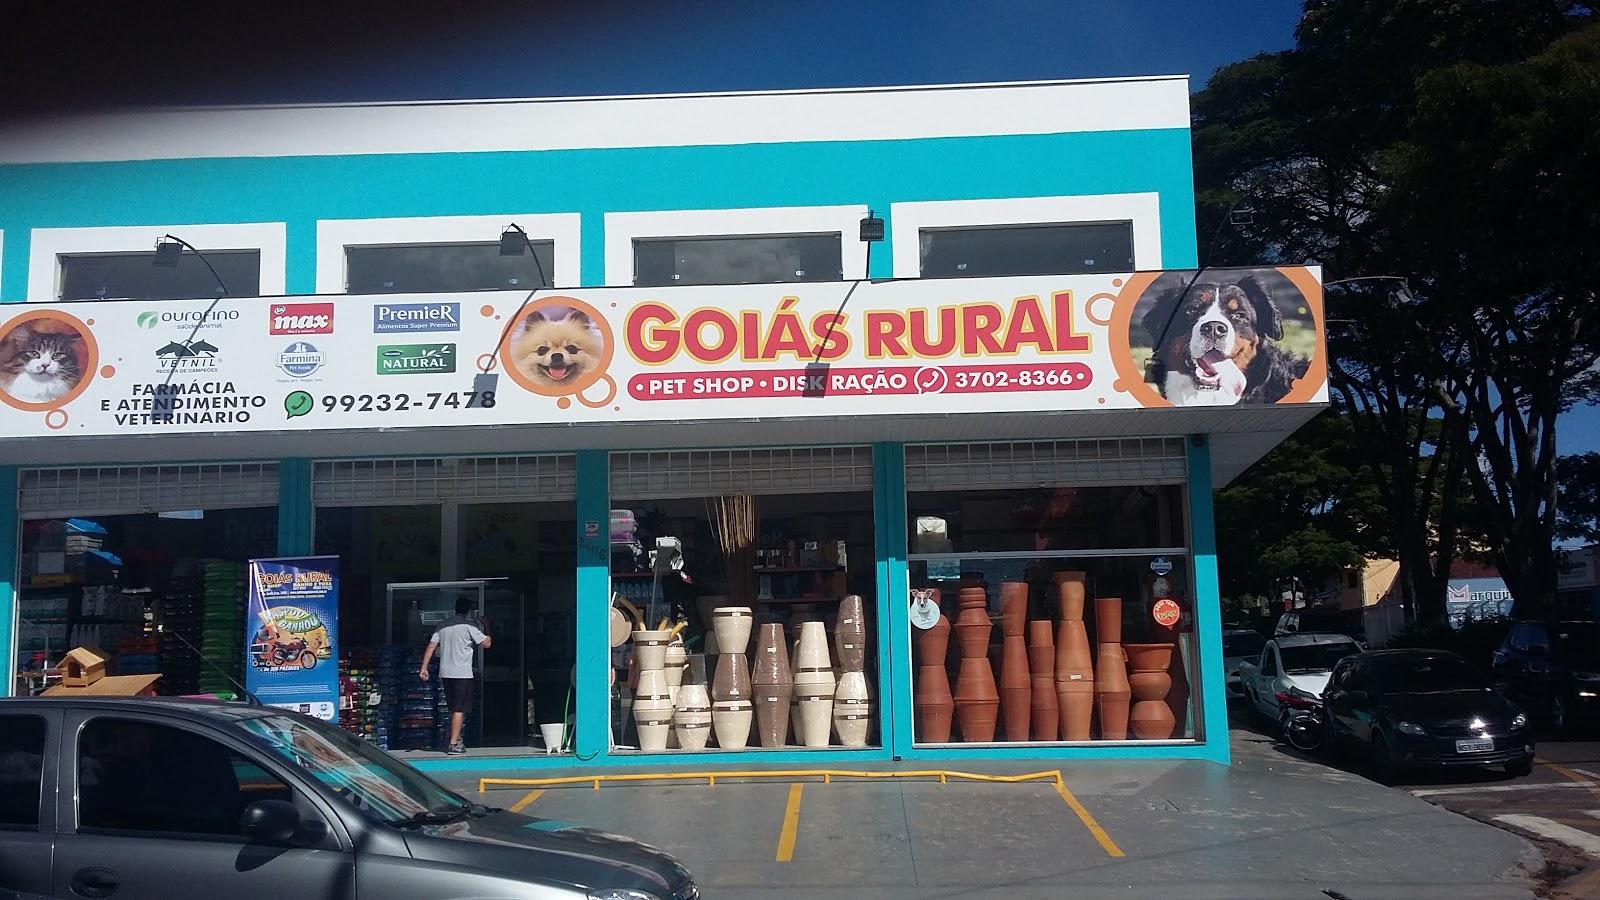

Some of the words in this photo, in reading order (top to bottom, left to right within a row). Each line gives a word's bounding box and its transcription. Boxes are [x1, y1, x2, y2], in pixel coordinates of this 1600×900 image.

[274, 315, 329, 330] max
[410, 322, 428, 331] Super
[430, 321, 458, 329] Premium
[624, 296, 852, 366] GOIÁS
[863, 290, 1093, 359] RURAL
[160, 359, 216, 368] VETNIL
[280, 353, 321, 363] Farmina
[383, 357, 448, 369] NATURAL
[132, 379, 236, 396] FARMÁCIA
[649, 379, 687, 395] PET
[692, 377, 754, 394] SHOP
[773, 375, 825, 392] DISK
[831, 369, 908, 394] RAÇÃO
[955, 370, 1073, 388] 3702-8366
[100, 400, 110, 411] E
[117, 395, 266, 411] ATENDIMENTO
[321, 390, 497, 413] 99232-7478
[115, 408, 251, 426] VETERINÁRIO
[294, 570, 332, 582] RURAL
